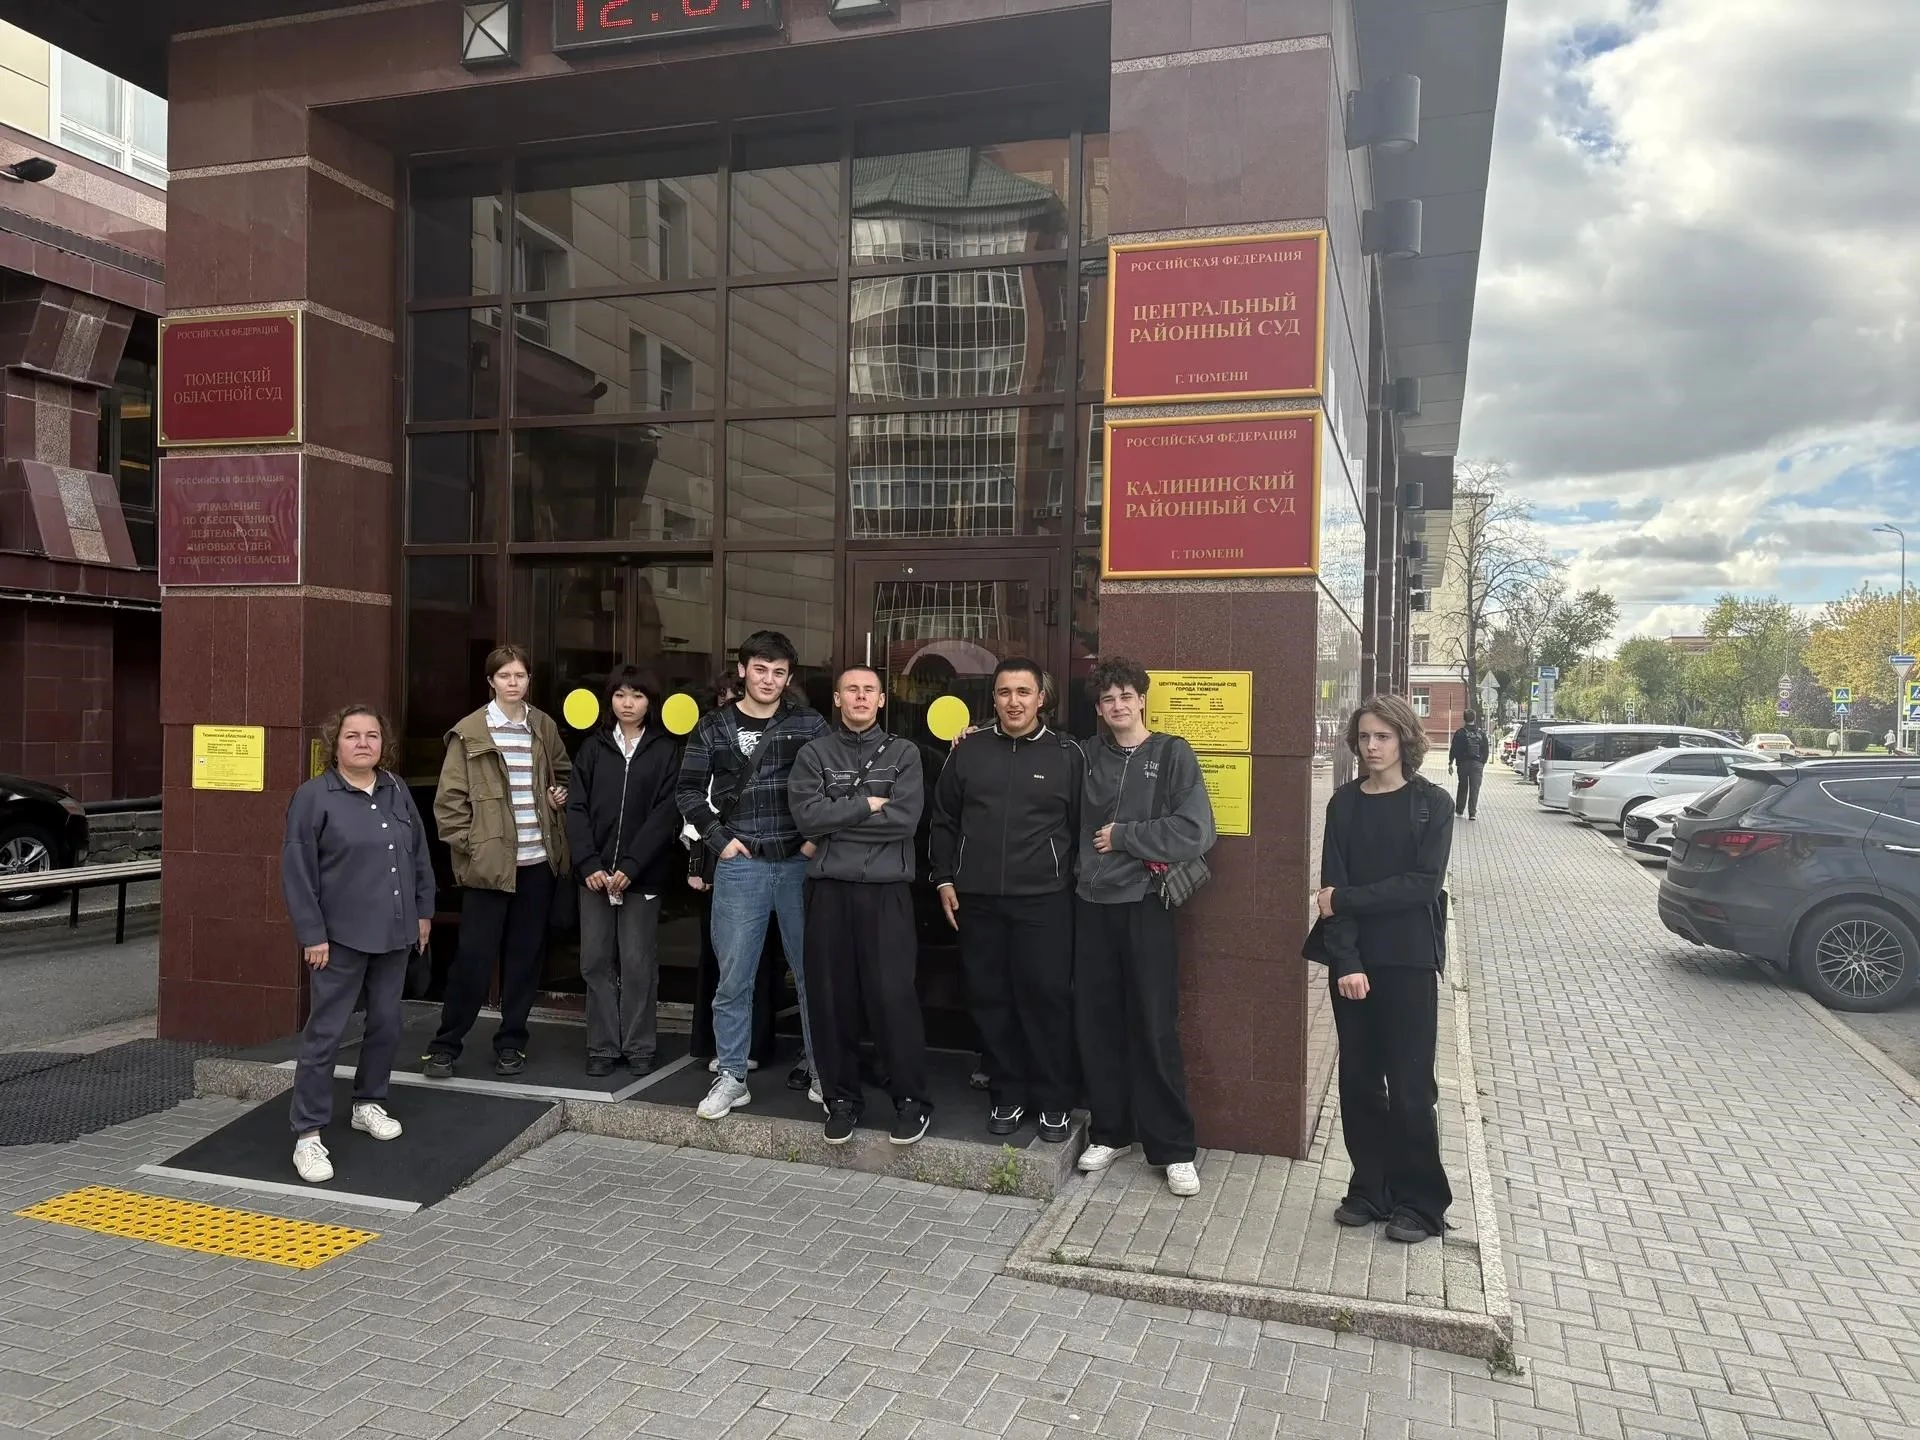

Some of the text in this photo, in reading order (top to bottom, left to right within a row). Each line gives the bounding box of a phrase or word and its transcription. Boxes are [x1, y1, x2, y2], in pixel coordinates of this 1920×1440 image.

[1130, 250, 1303, 272] РОССИЙСКАЯ ФЕДЕРАЦИЯ
[1132, 292, 1297, 322] ЦЕНТРАЛЬНЫЙ
[177, 324, 279, 340] РОССИЙСКАЯ ФЕДЕРАЦИЯ
[1129, 317, 1301, 343] РАЙОННЫЙ СУД
[184, 366, 271, 386] ТЮМЕНСКИЙ
[1175, 371, 1249, 384] Г. ТЮМЕНИ
[173, 385, 283, 404] ОБЛАСТНОЙ СУД
[1126, 429, 1297, 448] РОССИЙСКАЯ ФЕДЕРАЦИЯ
[1126, 469, 1296, 496] КАЛИНИНСКИЙ
[1125, 495, 1296, 518] РАЙОННЫЙ СУД
[182, 515, 276, 525] ПО ОБЕСПЕЧЕНИЮ
[191, 529, 268, 538] ДЕЯТЕЛЬНОСТИ
[178, 556, 243, 566] ТЮМЕНСКОЙ
[245, 555, 290, 565] ОБЛАСТИ
[1171, 548, 1244, 560] Г. ТЮМЕНИ
